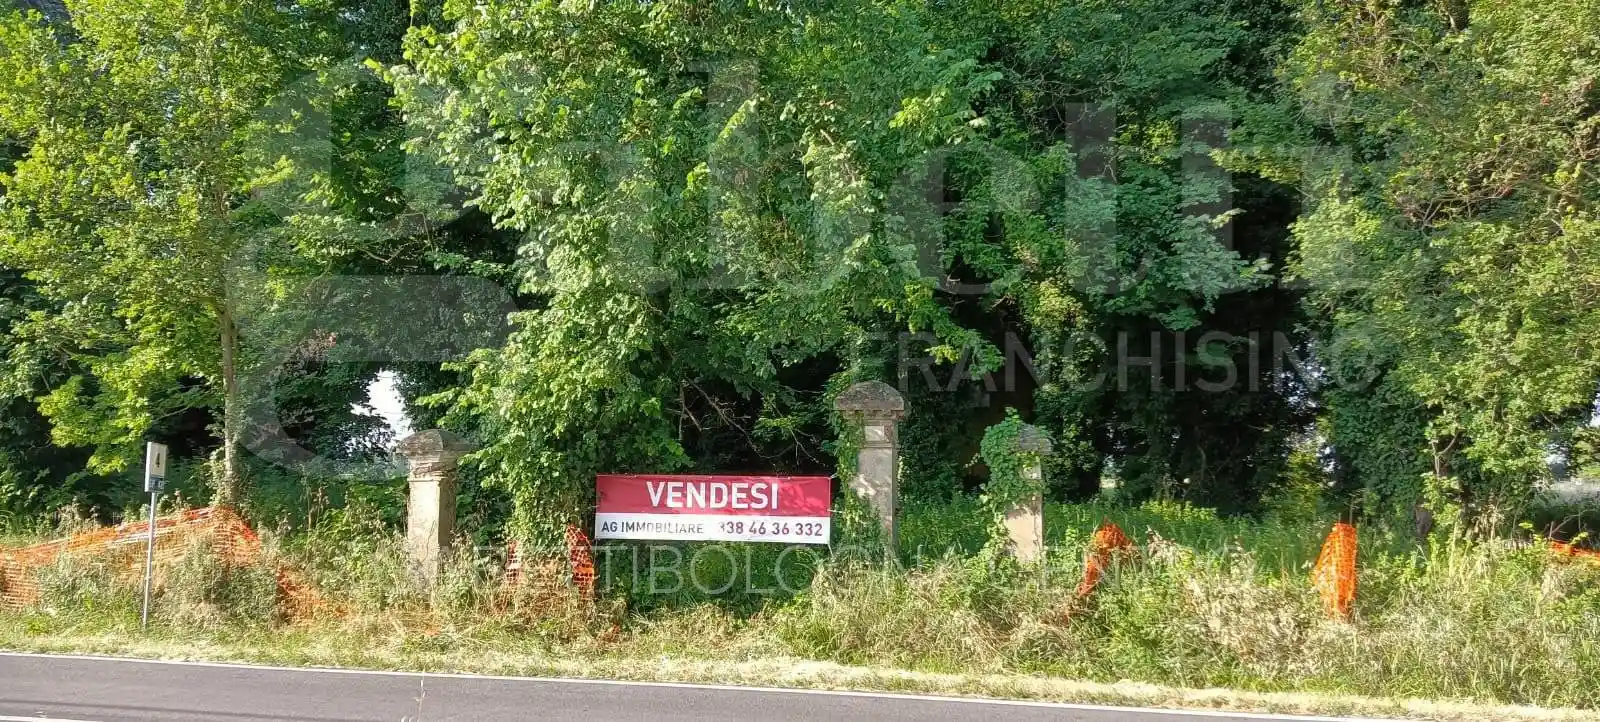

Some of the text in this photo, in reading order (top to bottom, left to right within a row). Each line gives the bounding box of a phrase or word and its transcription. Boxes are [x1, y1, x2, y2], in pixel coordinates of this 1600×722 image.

[645, 480, 779, 510] VENDESI
[601, 520, 618, 533] AG
[621, 521, 704, 534] IMMOBILIARE
[748, 521, 767, 535] 46
[771, 522, 790, 536] 36
[795, 522, 823, 537] 332
